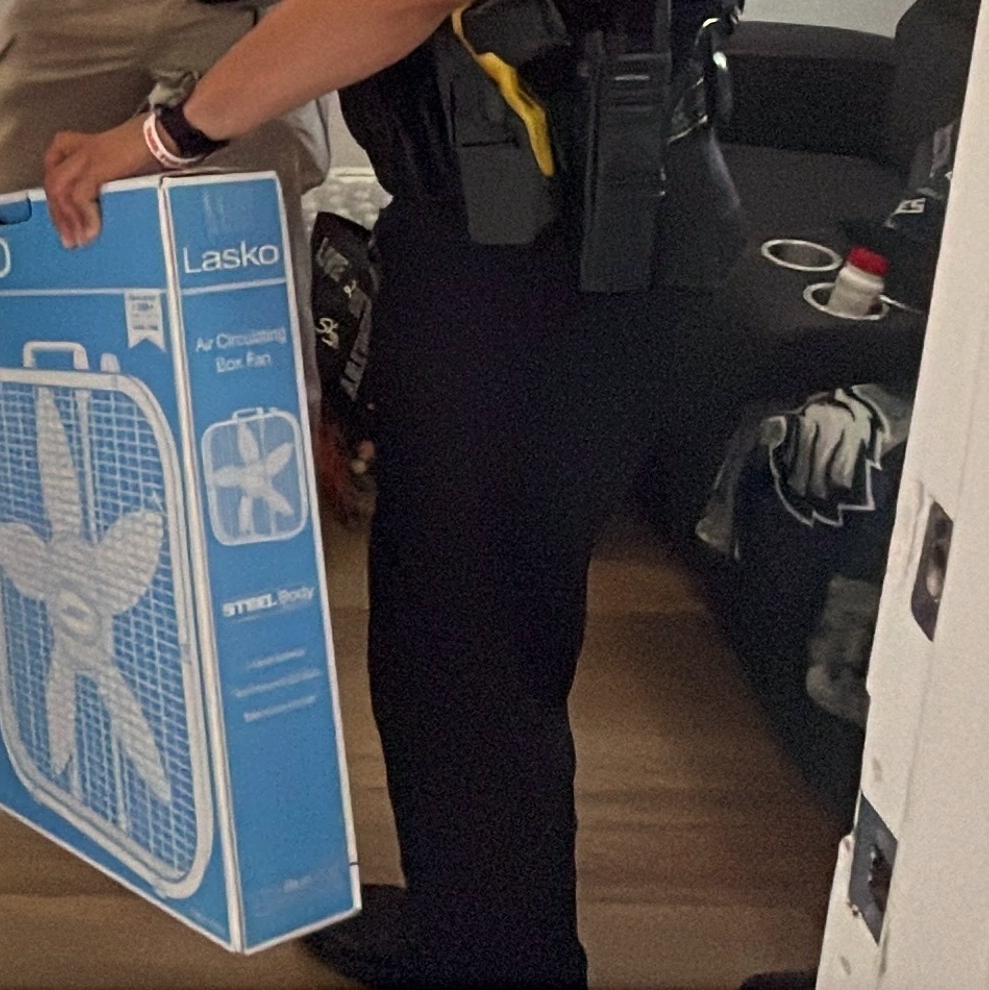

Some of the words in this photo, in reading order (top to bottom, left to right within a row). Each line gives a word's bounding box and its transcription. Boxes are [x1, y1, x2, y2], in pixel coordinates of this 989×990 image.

[183, 240, 280, 274] Lasko
[216, 356, 243, 373] Box
[247, 351, 272, 367] Fan
